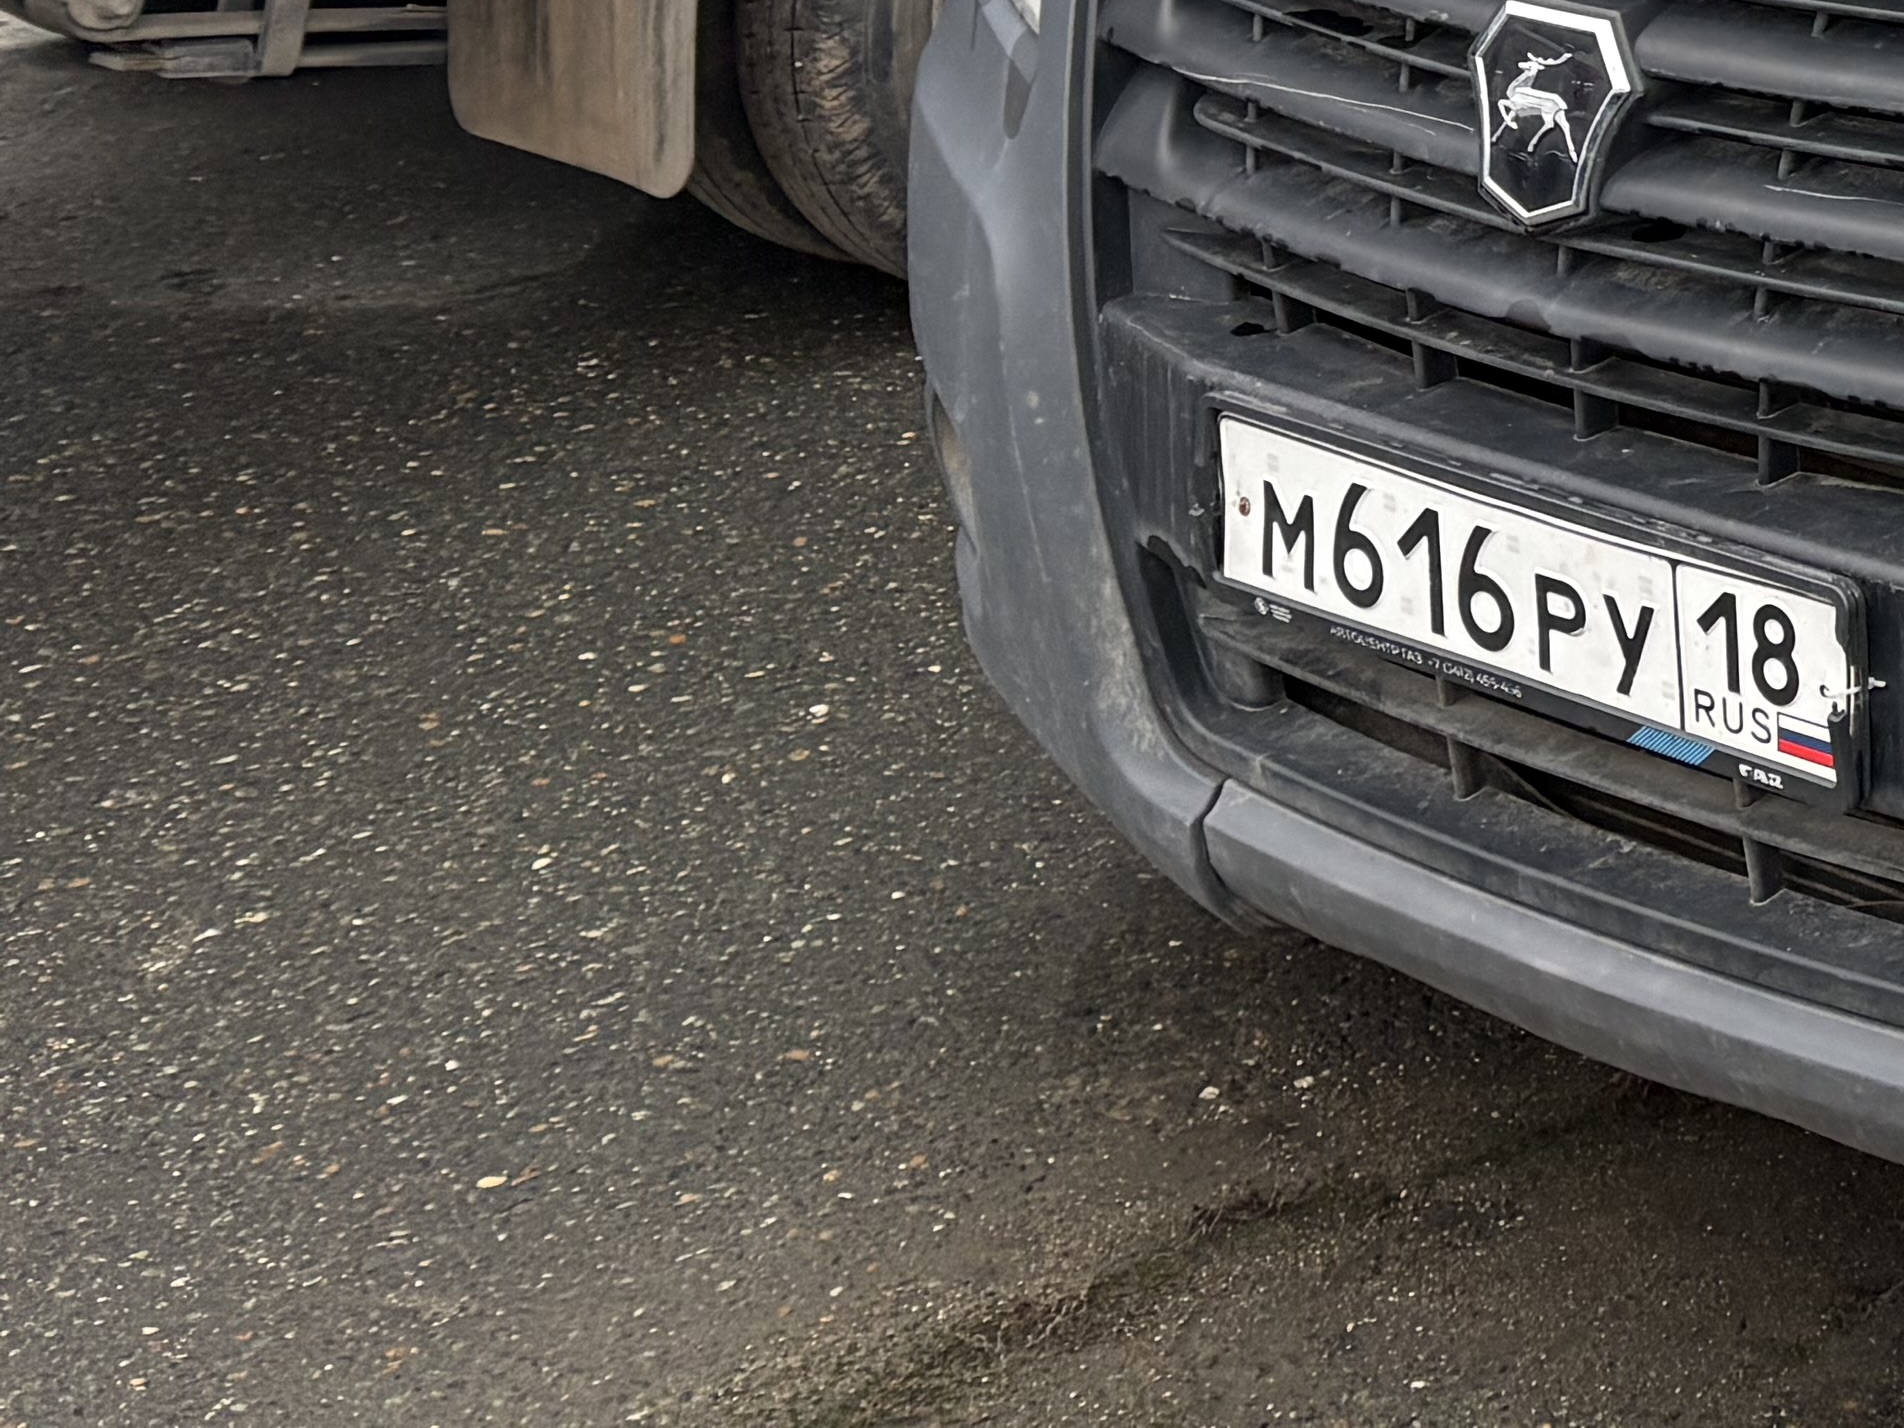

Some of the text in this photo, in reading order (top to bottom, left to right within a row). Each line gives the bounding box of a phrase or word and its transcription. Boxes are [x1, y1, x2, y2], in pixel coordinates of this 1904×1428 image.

[1261, 479, 1799, 707] М616РУ 18
[1694, 690, 1773, 745] RUS
